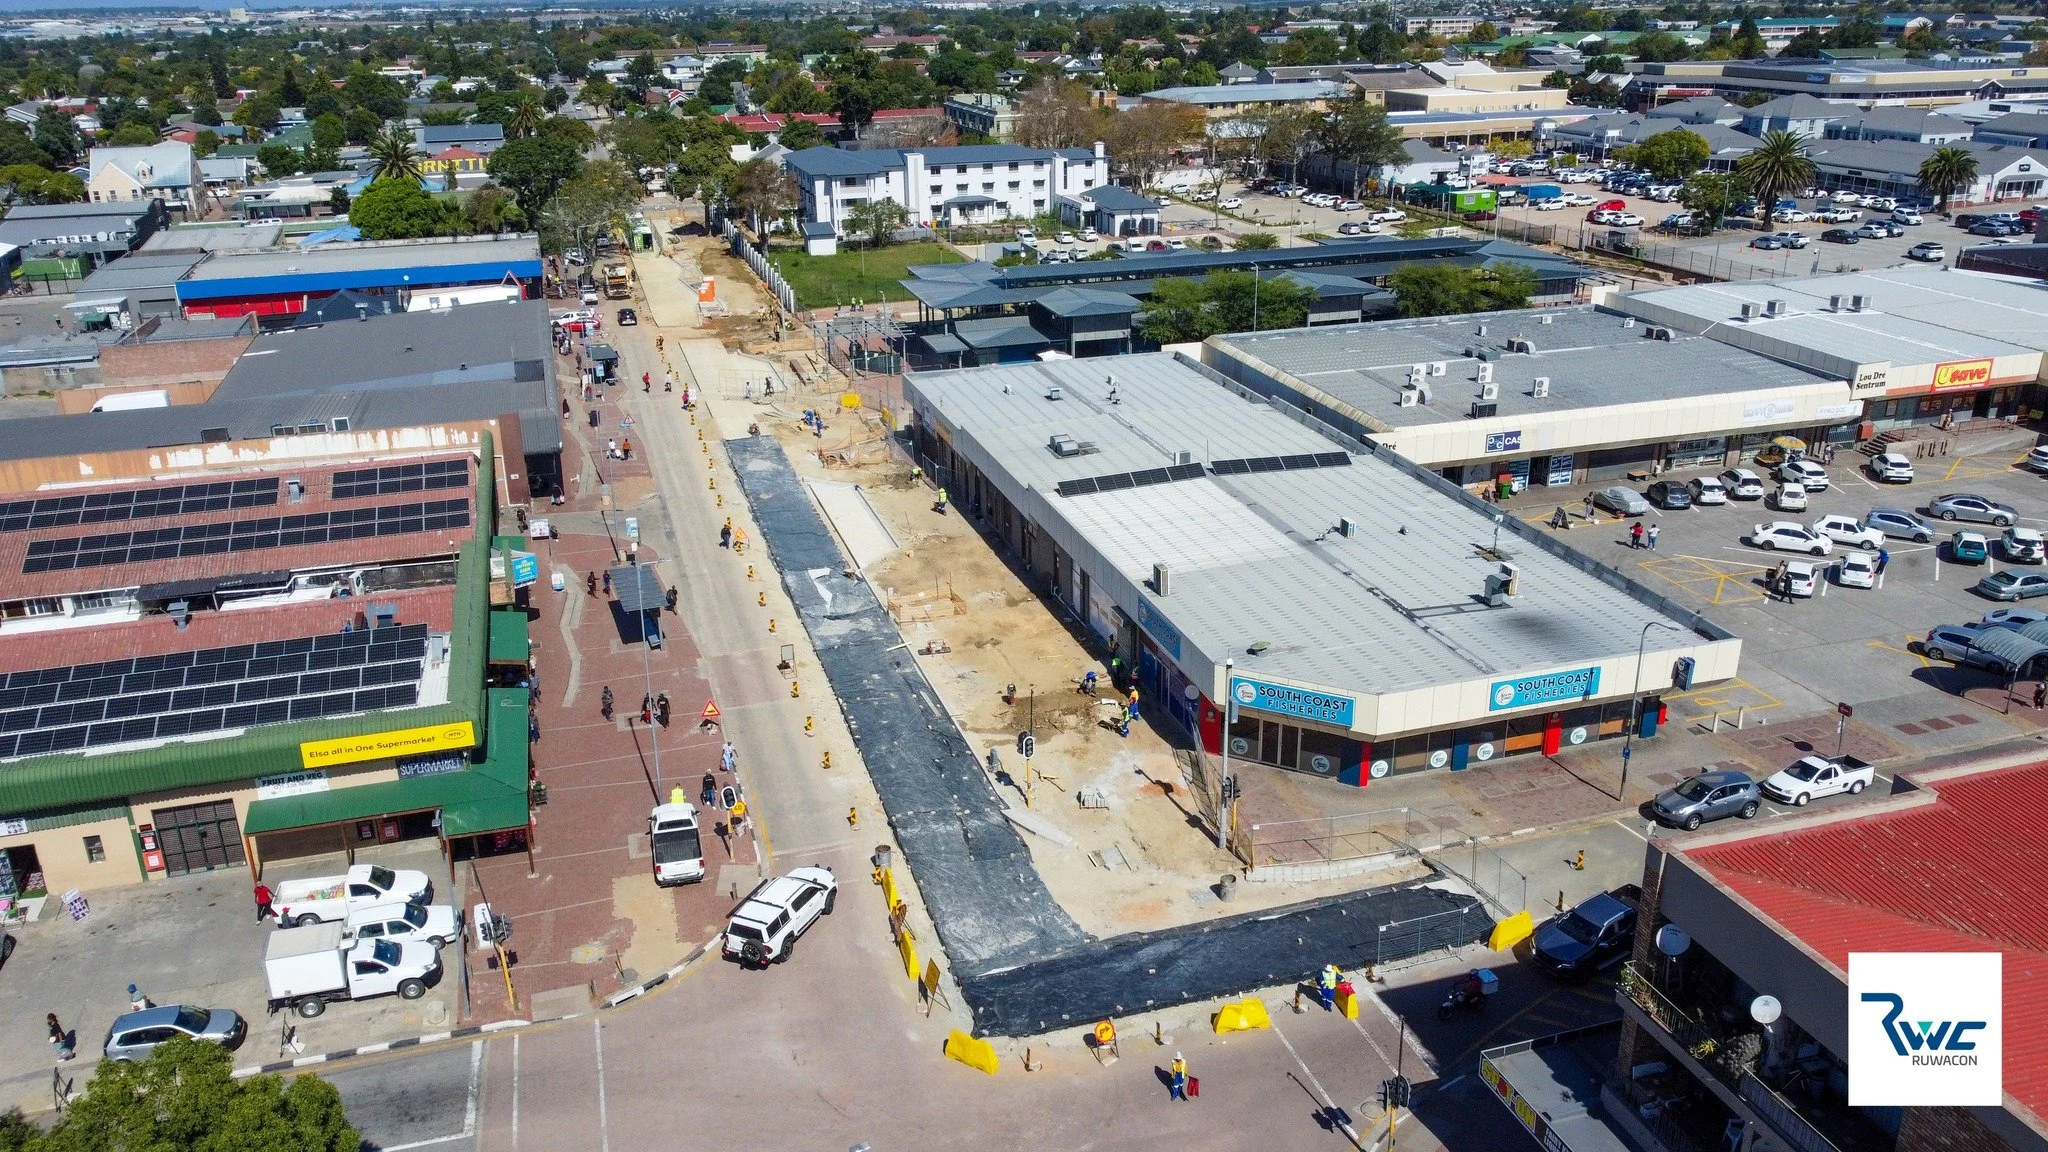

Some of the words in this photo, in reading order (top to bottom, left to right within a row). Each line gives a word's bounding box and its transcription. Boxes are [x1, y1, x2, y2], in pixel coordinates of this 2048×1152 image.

[1859, 373, 1871, 382] Lou
[1873, 370, 1886, 380] Dré
[1938, 366, 1986, 385] Usave
[1855, 380, 1886, 390] Sentrum
[1517, 679, 1555, 693] SOUTH
[1556, 671, 1595, 686] COAST
[1259, 685, 1301, 703] SOUTH
[1303, 694, 1347, 711] COAST
[1524, 684, 1586, 701] FISHERIES
[1267, 699, 1337, 720] FISHERIES
[309, 750, 329, 758] Elsa
[344, 746, 354, 754] in
[355, 744, 374, 752] One
[376, 735, 436, 750] Supermarket
[400, 758, 460, 776] SUPERMARKET
[262, 778, 285, 787] FRUIT
[287, 775, 305, 783] AND
[306, 772, 323, 780] VEG
